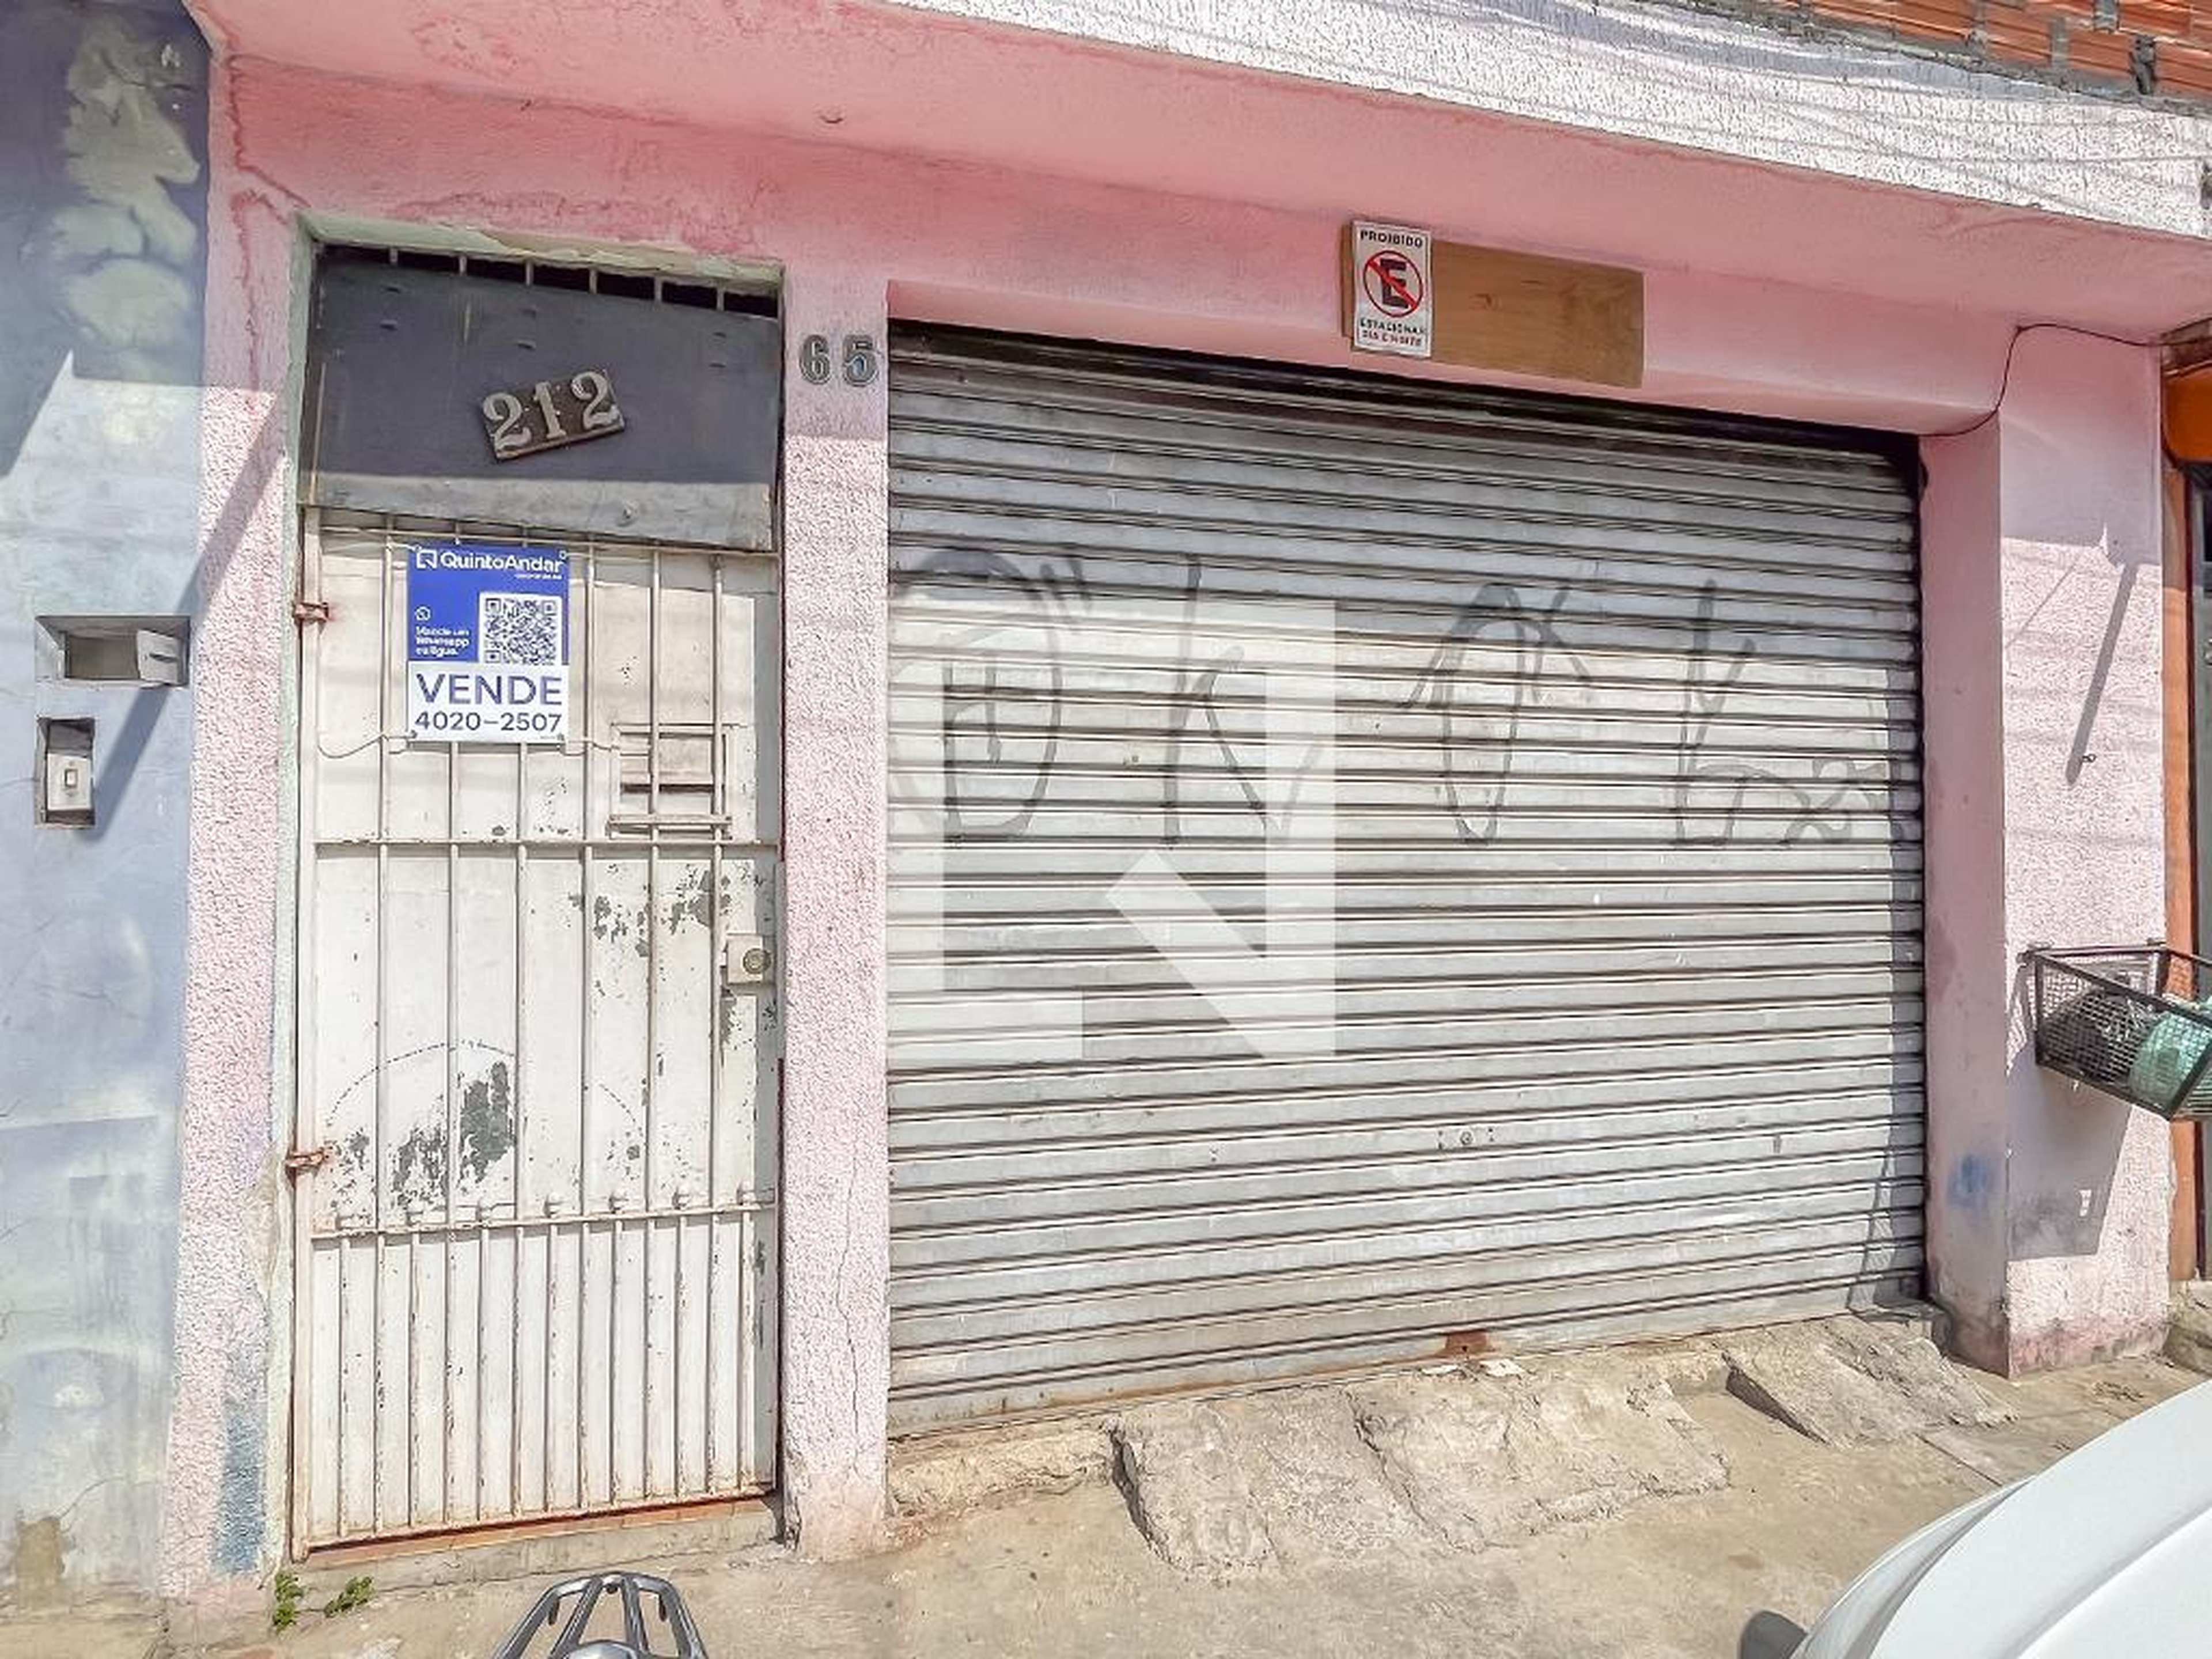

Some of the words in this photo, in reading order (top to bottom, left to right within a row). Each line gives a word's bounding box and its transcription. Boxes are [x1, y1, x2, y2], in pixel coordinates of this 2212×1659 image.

[1360, 230, 1423, 248] PROIBIDO
[800, 334, 880, 387] 65
[483, 371, 621, 450] 212
[440, 551, 564, 573] QuintoAndar
[416, 673, 562, 705] VENDE
[415, 711, 562, 732] 4020-2507
